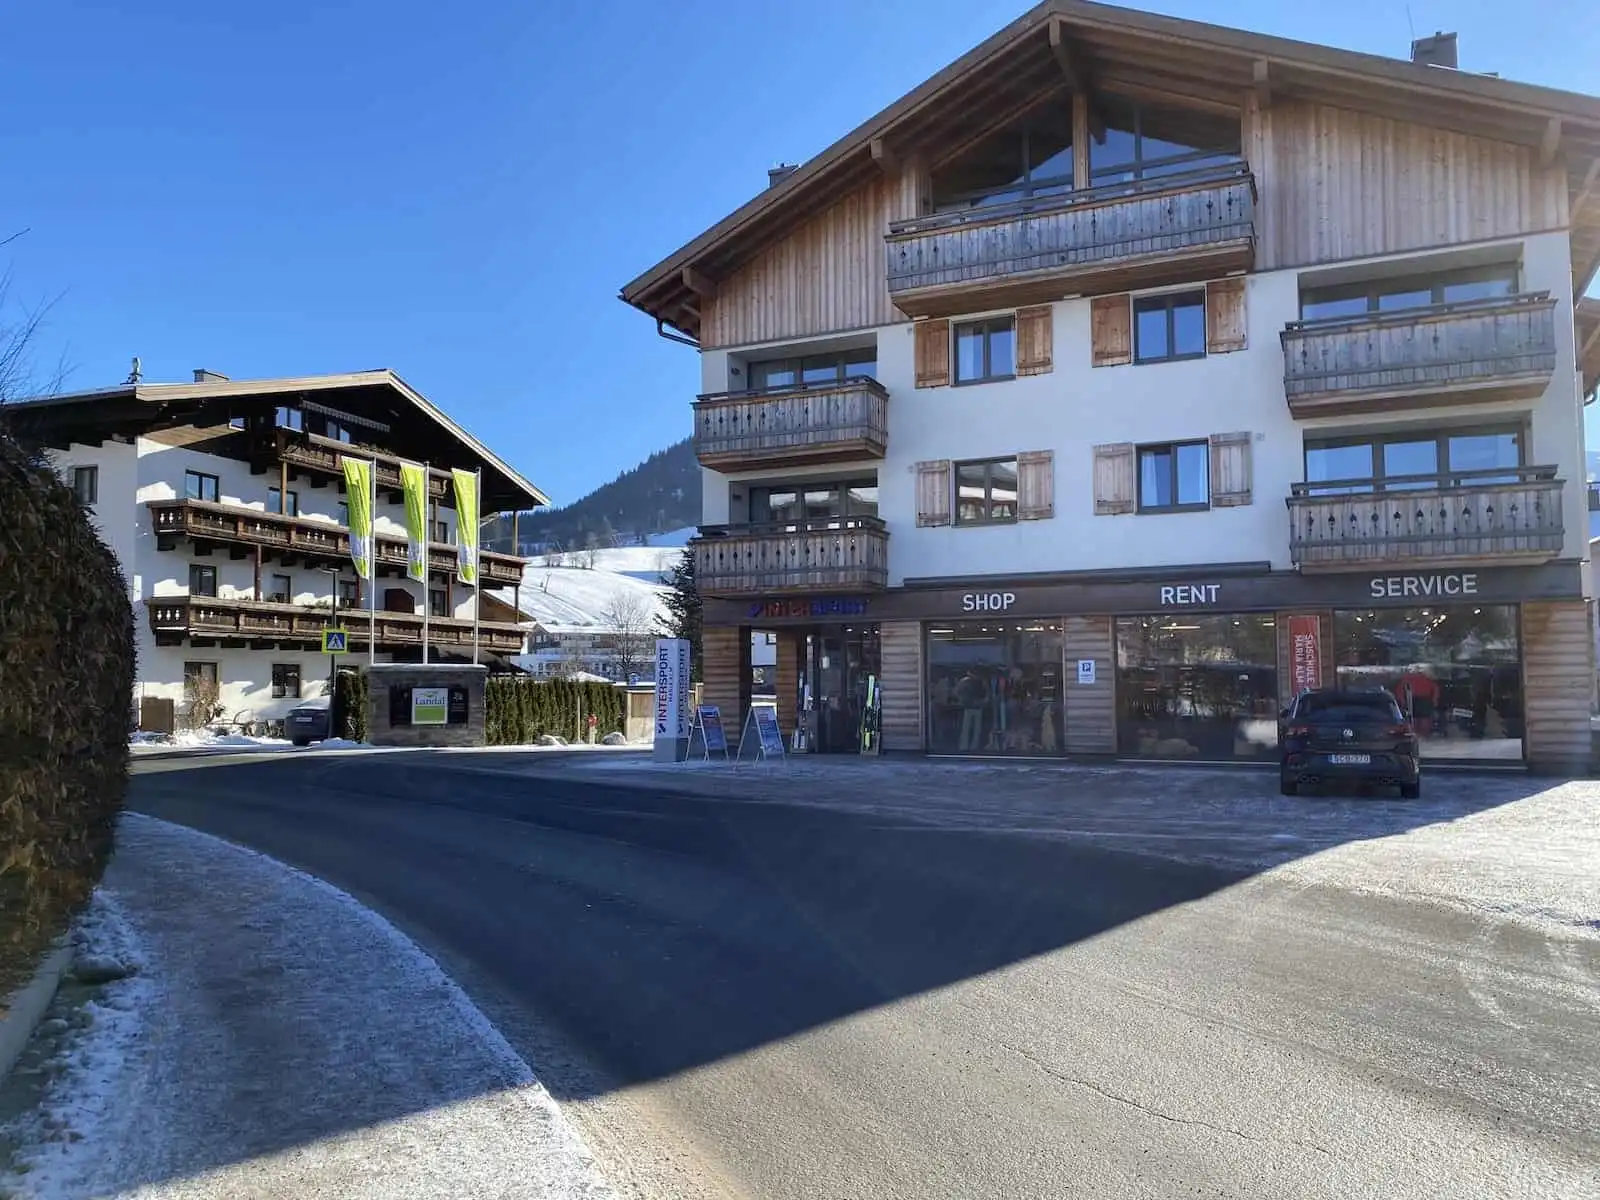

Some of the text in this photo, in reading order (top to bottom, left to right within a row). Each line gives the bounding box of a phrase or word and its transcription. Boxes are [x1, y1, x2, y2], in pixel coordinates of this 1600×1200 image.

[1160, 585, 1221, 605] RENT
[1370, 574, 1478, 597] SERVICE
[962, 592, 1015, 611] SHOP
[658, 646, 668, 721] INTERSPORT
